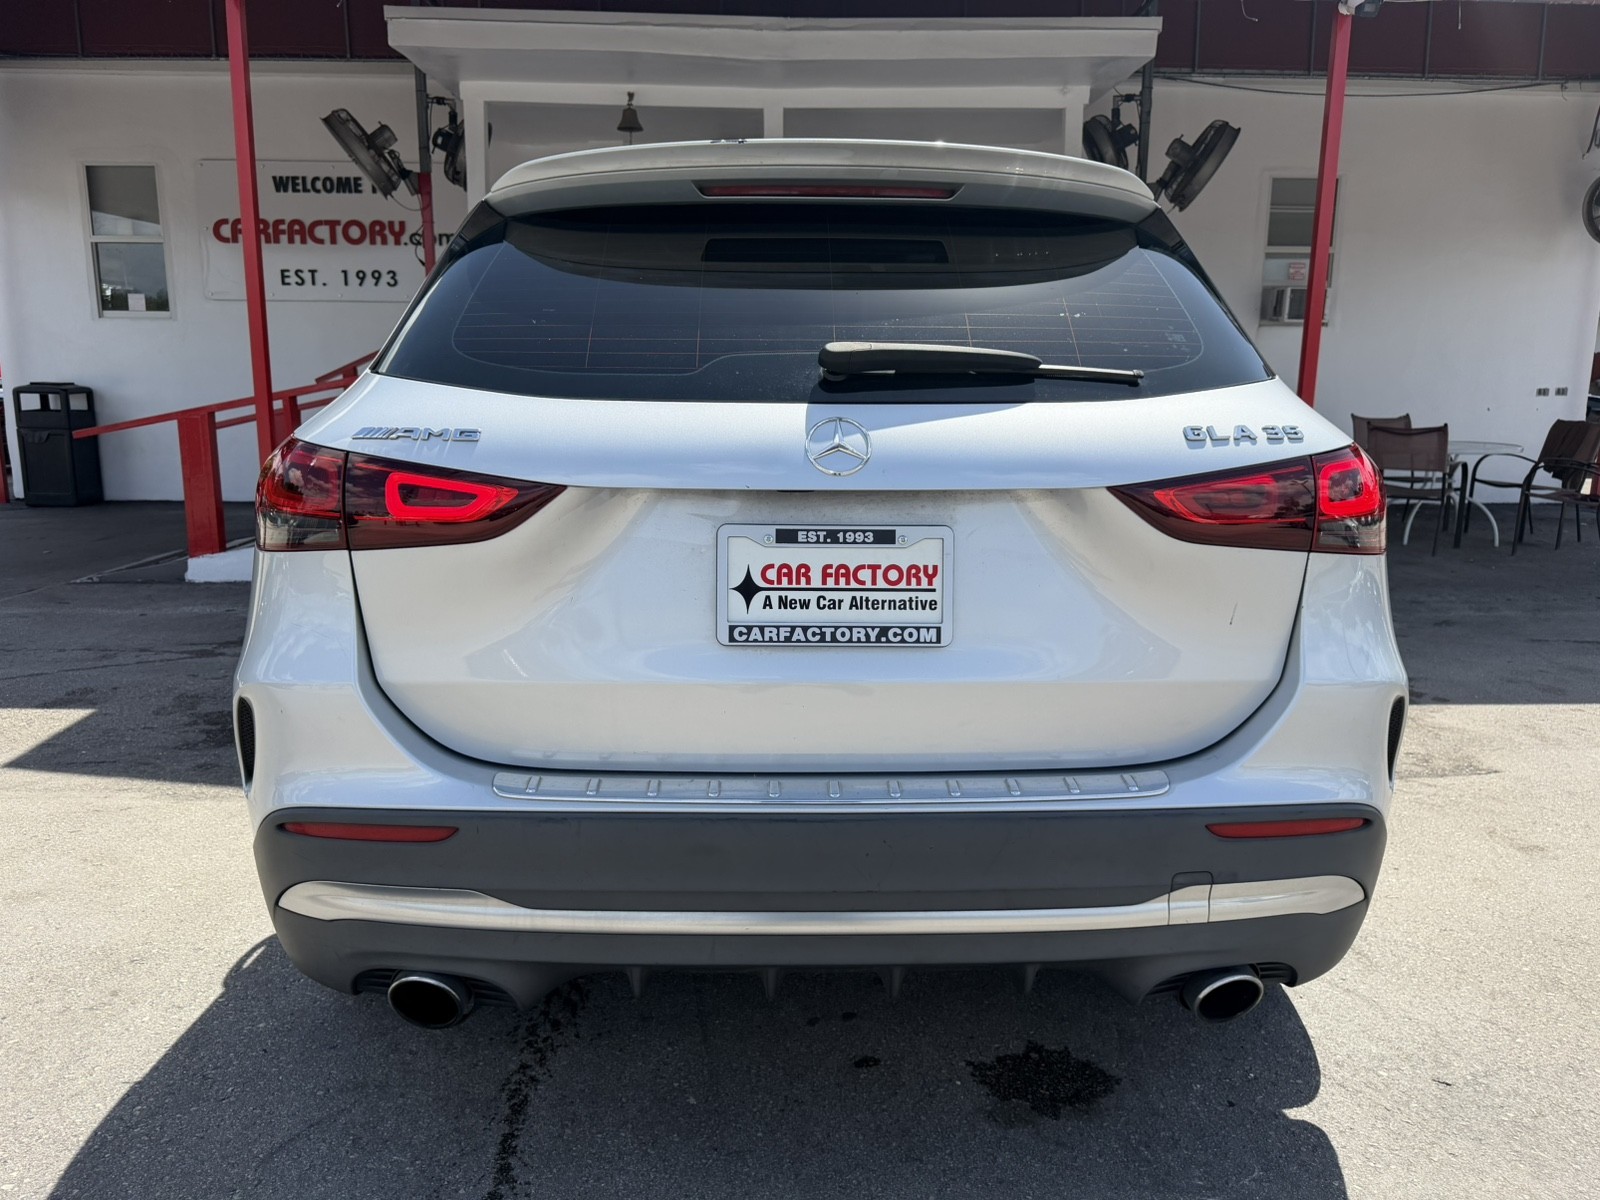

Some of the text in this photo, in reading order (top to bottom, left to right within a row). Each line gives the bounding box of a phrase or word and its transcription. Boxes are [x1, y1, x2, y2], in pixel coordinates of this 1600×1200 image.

[272, 175, 362, 194] WELCOME
[280, 269, 398, 287] EST. 1993
[390, 427, 481, 441] AMG
[1182, 425, 1304, 442] GLA 35
[797, 531, 874, 543] EST. 1993
[760, 563, 939, 587] CAR FACTORY
[762, 595, 938, 611] A New Car Alternative
[733, 626, 937, 643] CARFACTORY.COM
